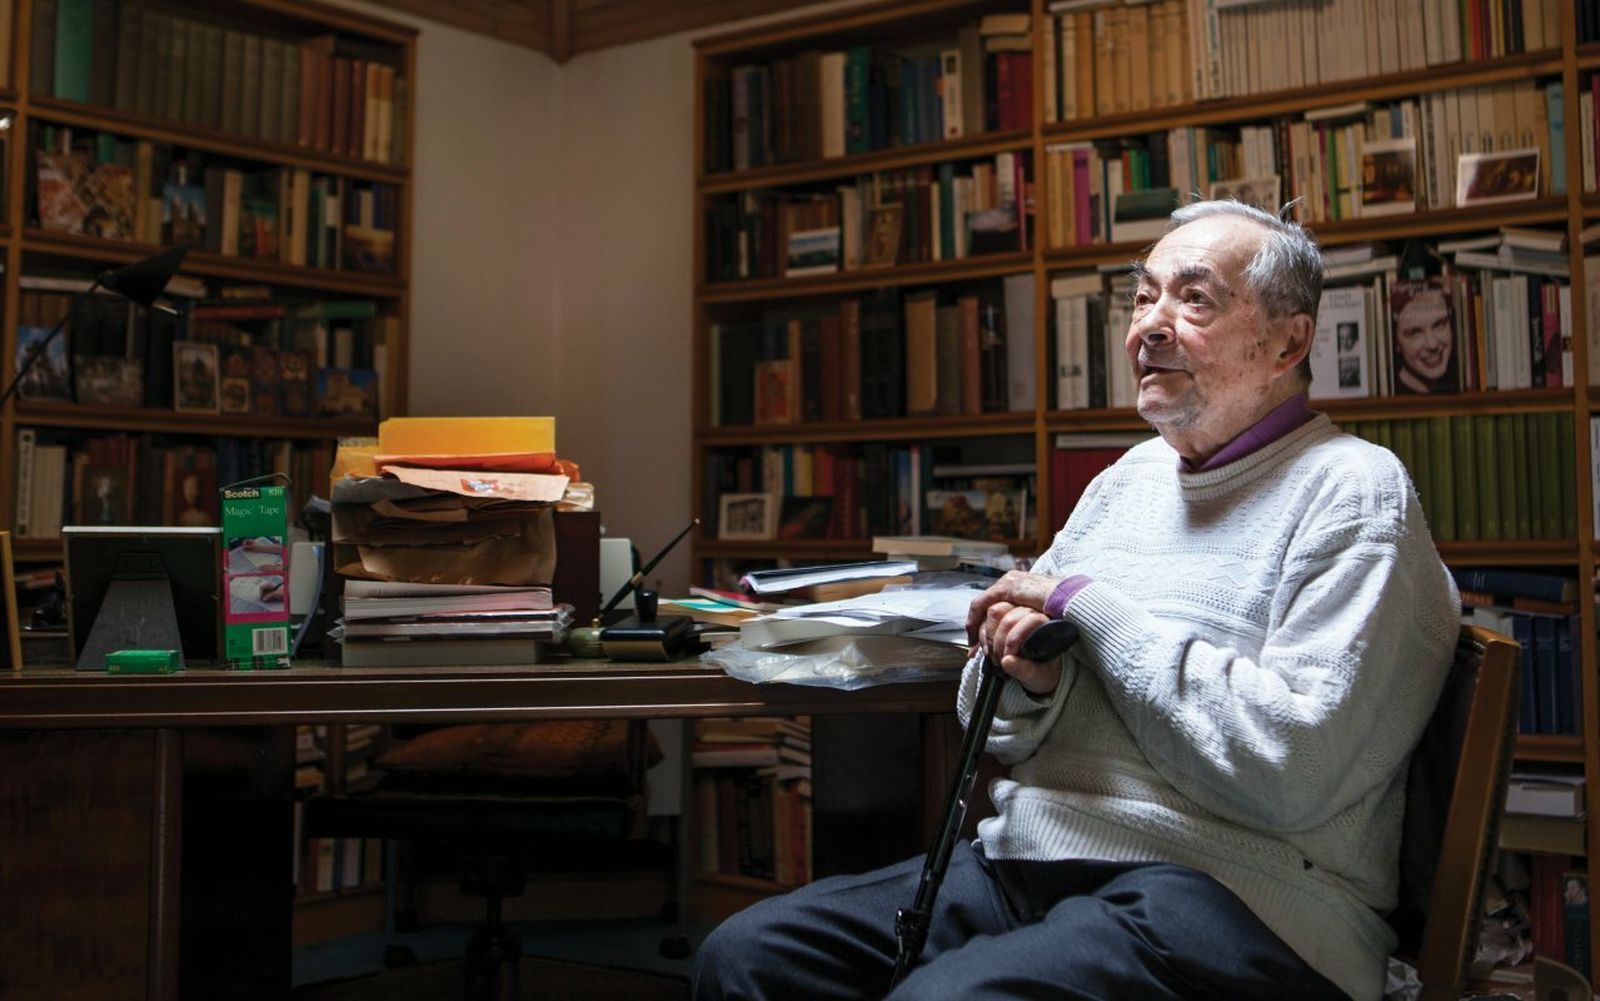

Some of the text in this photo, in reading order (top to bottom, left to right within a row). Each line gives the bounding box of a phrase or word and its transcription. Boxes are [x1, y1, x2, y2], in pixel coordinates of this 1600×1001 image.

[224, 489, 260, 499] Scotch
[225, 504, 280, 517] Magic Tape
